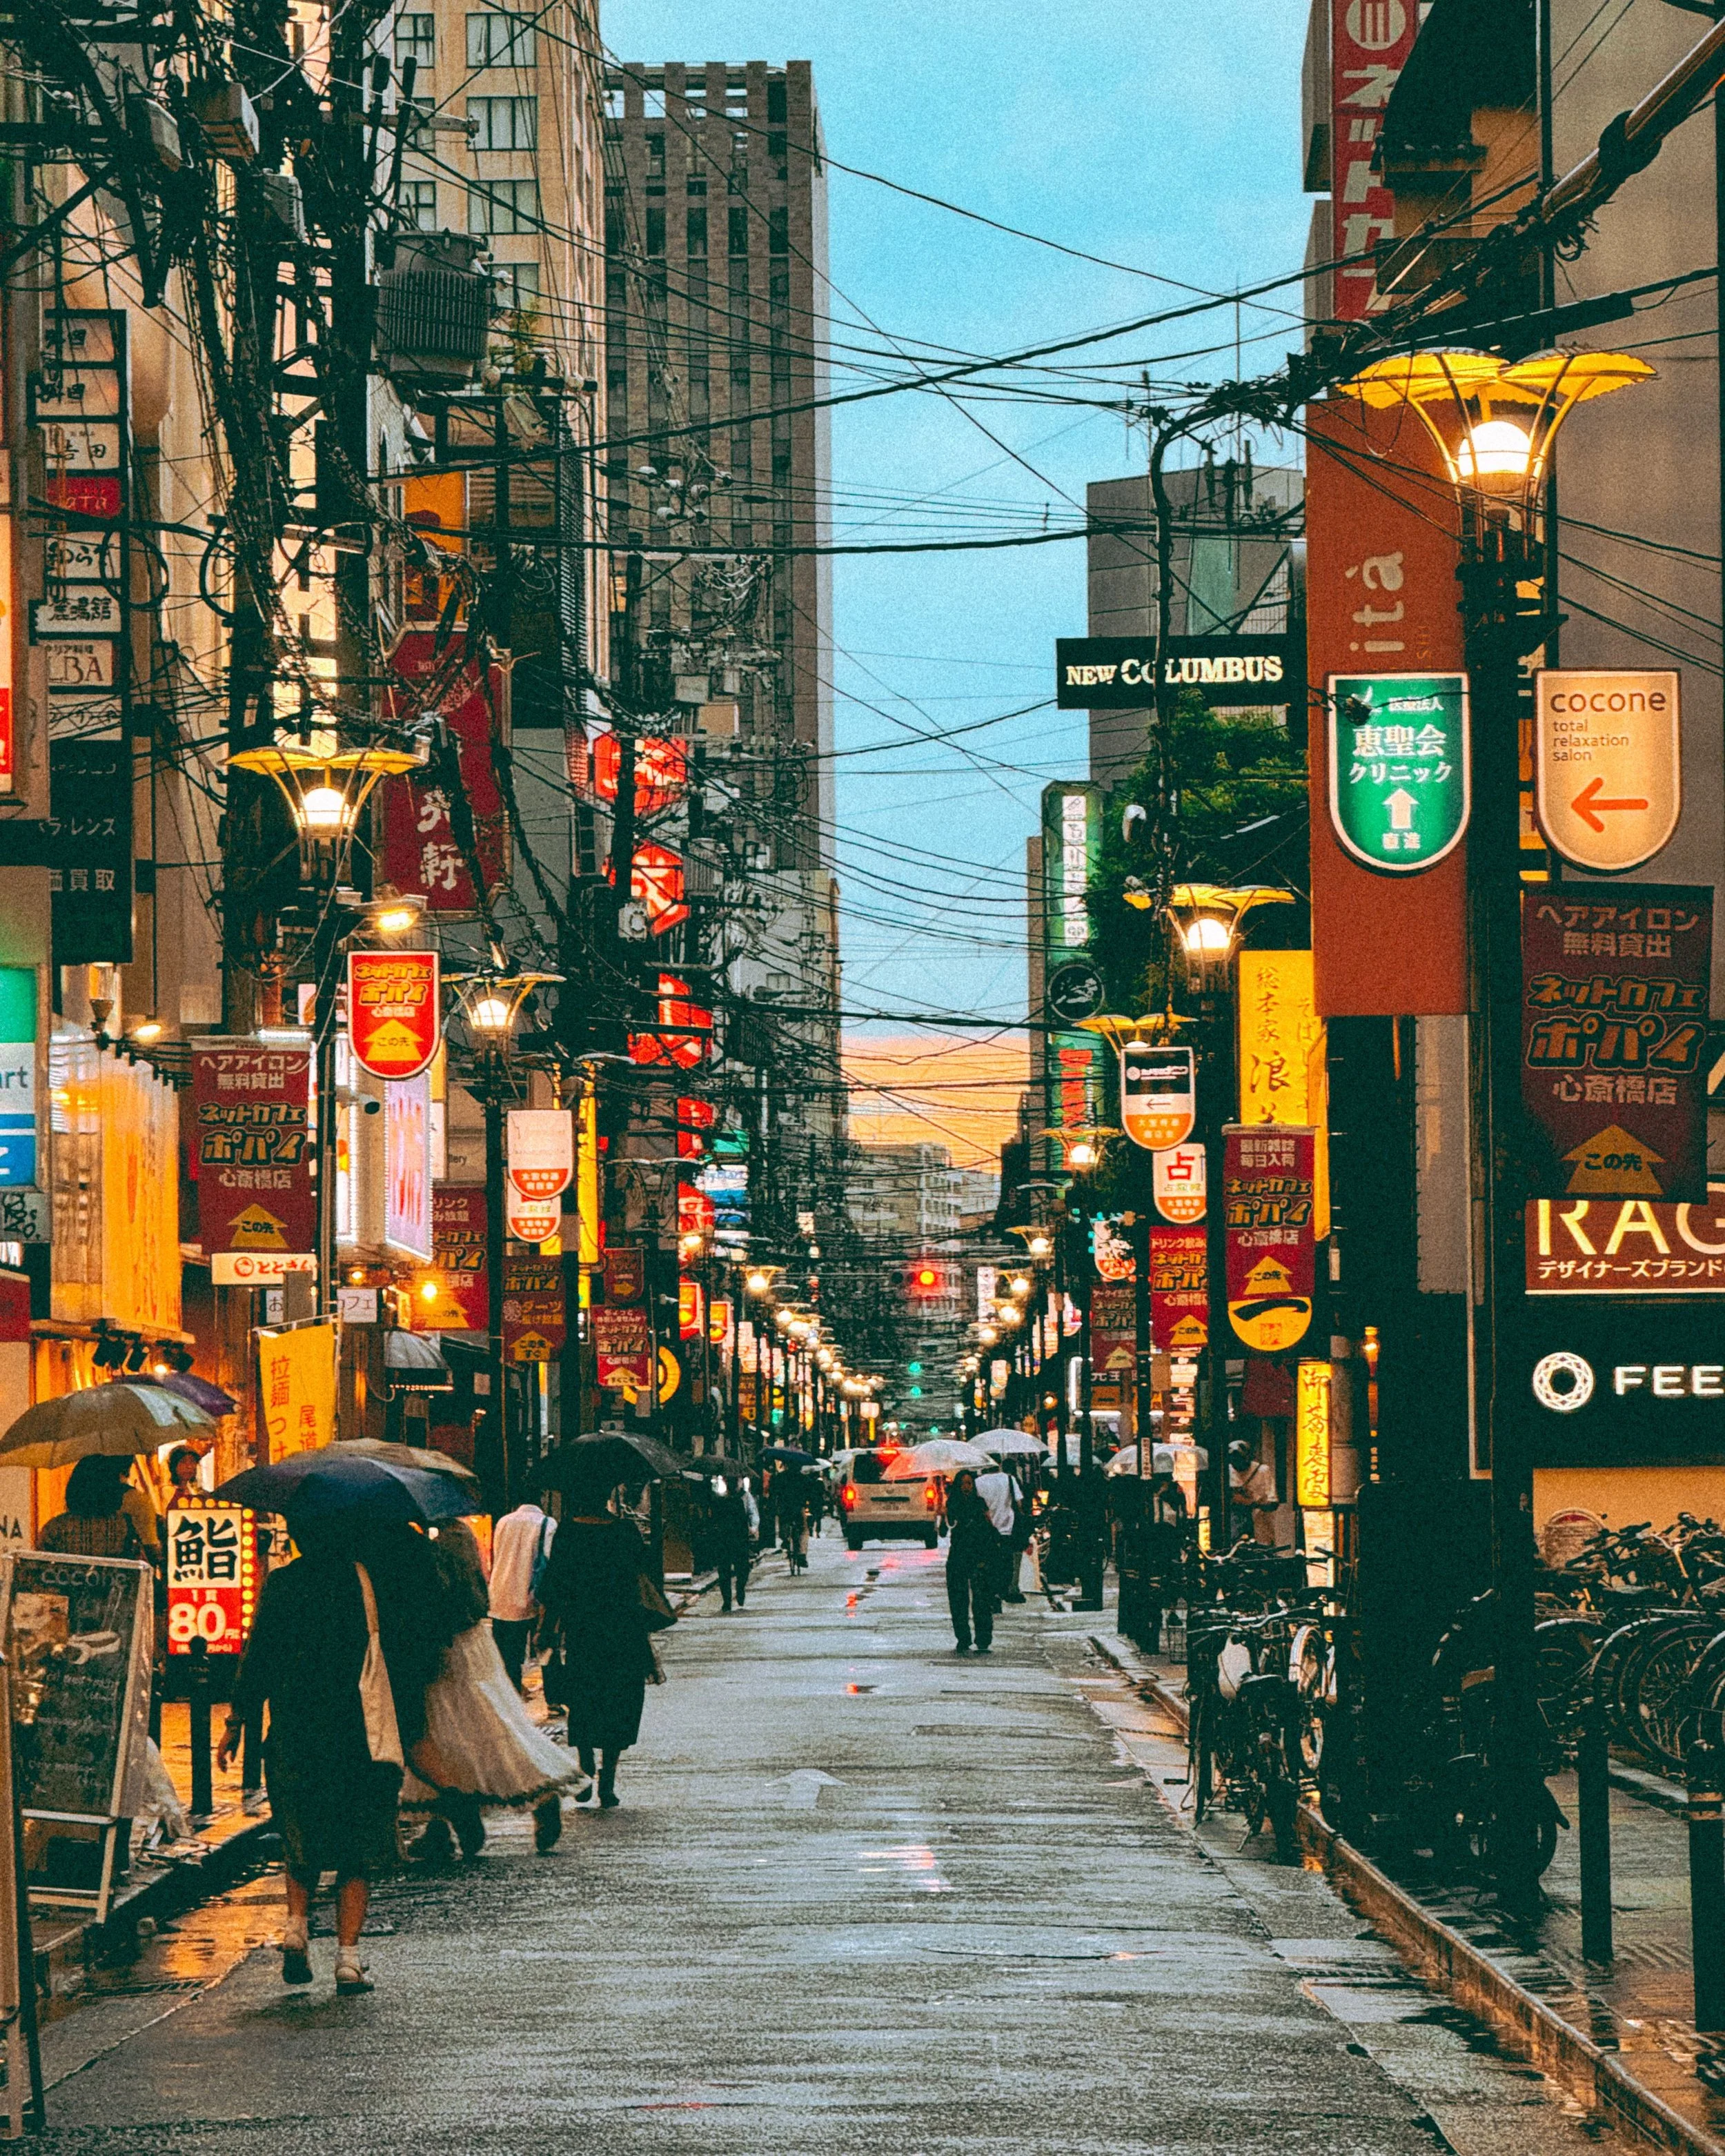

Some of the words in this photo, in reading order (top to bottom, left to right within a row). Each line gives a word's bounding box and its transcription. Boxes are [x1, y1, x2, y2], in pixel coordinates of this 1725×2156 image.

[1066, 665, 1118, 685] NEW
[1550, 692, 1666, 713] cocone
[1553, 719, 1588, 732] total
[1352, 724, 1446, 756] 恵聖会
[1553, 733, 1630, 746] relaxation
[1552, 749, 1592, 762] salon
[1350, 762, 1452, 784] クリニック
[1536, 905, 1699, 931] ヘアアイロン
[1563, 931, 1672, 958] 無料貸出
[355, 965, 431, 979] ネットカフェ
[360, 983, 426, 1003] ポパイ
[1532, 975, 1702, 1009] ネットカフェ
[378, 1037, 410, 1046] この先
[1531, 1016, 1699, 1063] ポパイ
[199, 1055, 303, 1072] ヘアアイロン
[217, 1073, 285, 1090] 無料貸出
[1552, 1075, 1678, 1104] 心斎橋店
[199, 1104, 305, 1126] ネットカフェ
[202, 1129, 305, 1164] ポパイ
[1167, 1151, 1194, 1180] 占
[1584, 1153, 1642, 1171] この先
[1228, 1178, 1311, 1195] ネットカフェ
[1228, 1197, 1311, 1227] ポパイ
[241, 1220, 275, 1234] この先
[1254, 1271, 1282, 1281] この先
[1538, 1259, 1725, 1278] デザイナーズブランド
[504, 1275, 559, 1291] ポパイ
[1615, 1365, 1725, 1396] FEE
[172, 1515, 239, 1583] 鮨
